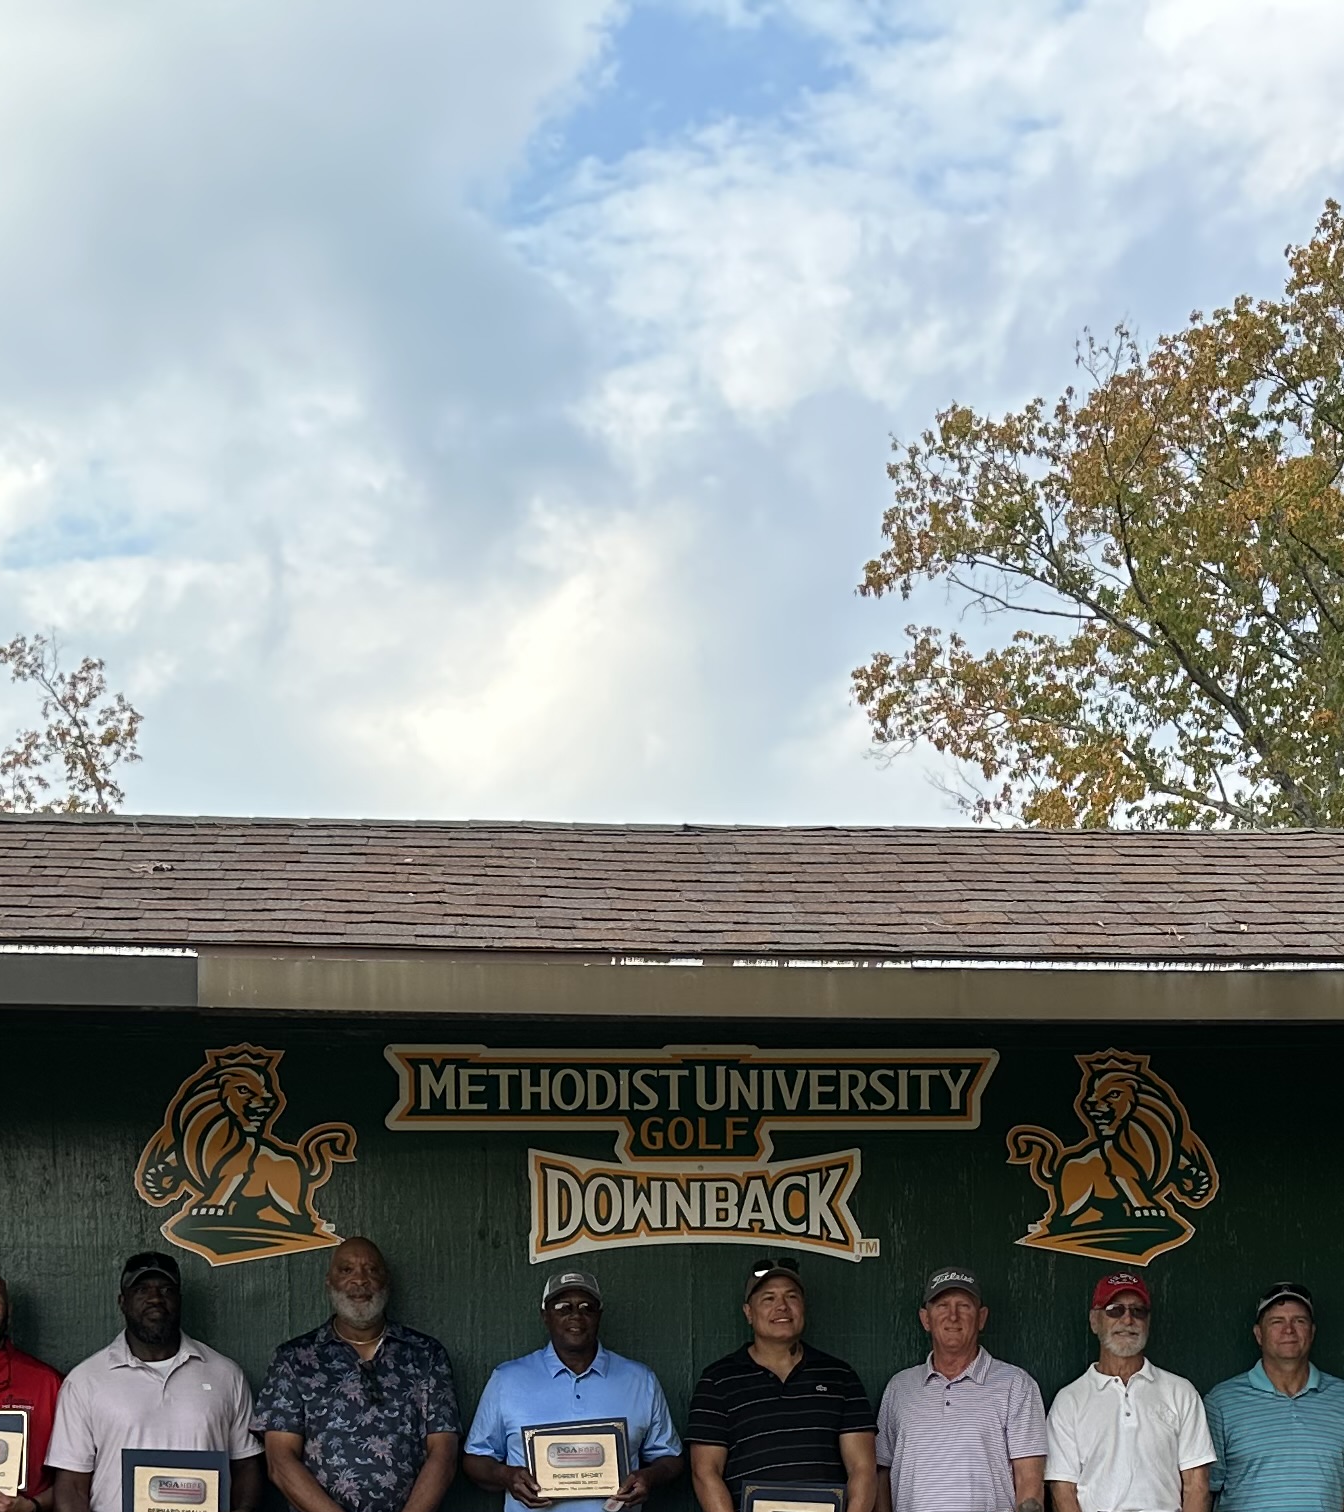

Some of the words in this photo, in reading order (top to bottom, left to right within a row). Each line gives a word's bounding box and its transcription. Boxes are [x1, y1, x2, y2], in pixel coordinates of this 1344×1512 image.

[419, 1065, 692, 1112] METHODIST
[694, 1065, 972, 1113] UNIVERSITY
[640, 1117, 750, 1152] GOLF
[545, 1167, 849, 1242] DOWNBACK
[159, 1480, 179, 1488] PGA
